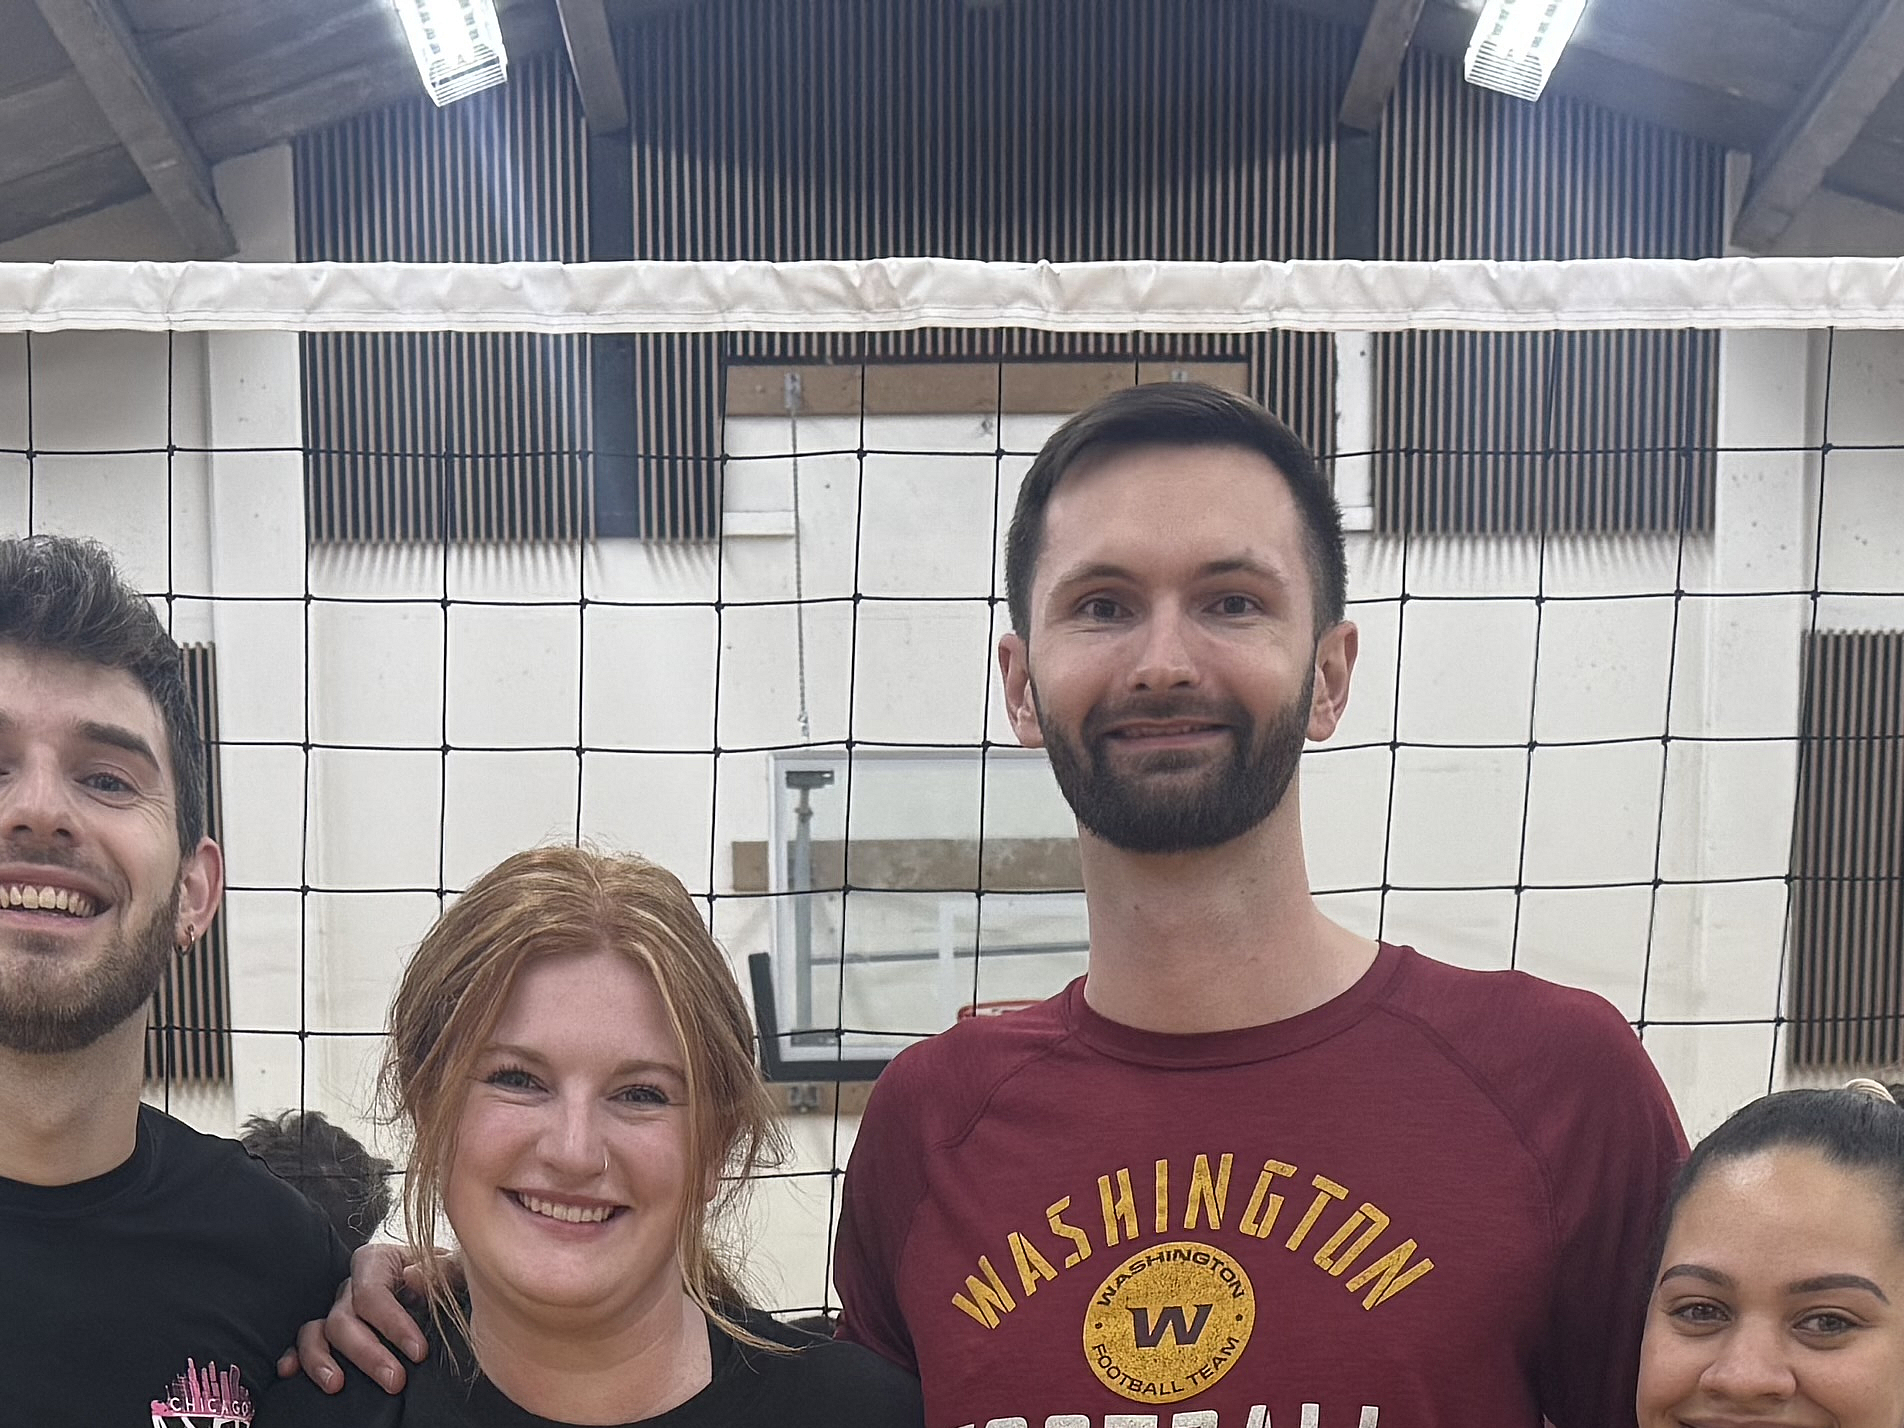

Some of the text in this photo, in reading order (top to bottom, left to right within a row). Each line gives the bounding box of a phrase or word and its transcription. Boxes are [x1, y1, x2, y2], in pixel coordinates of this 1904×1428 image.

[951, 1152, 1435, 1330] WASHINGTON
[1096, 1248, 1246, 1308] WASHINGTON
[1125, 1303, 1214, 1350] W
[1092, 1337, 1240, 1396] FOOTBALL TEAM
[169, 1396, 249, 1417] CHICAGO
